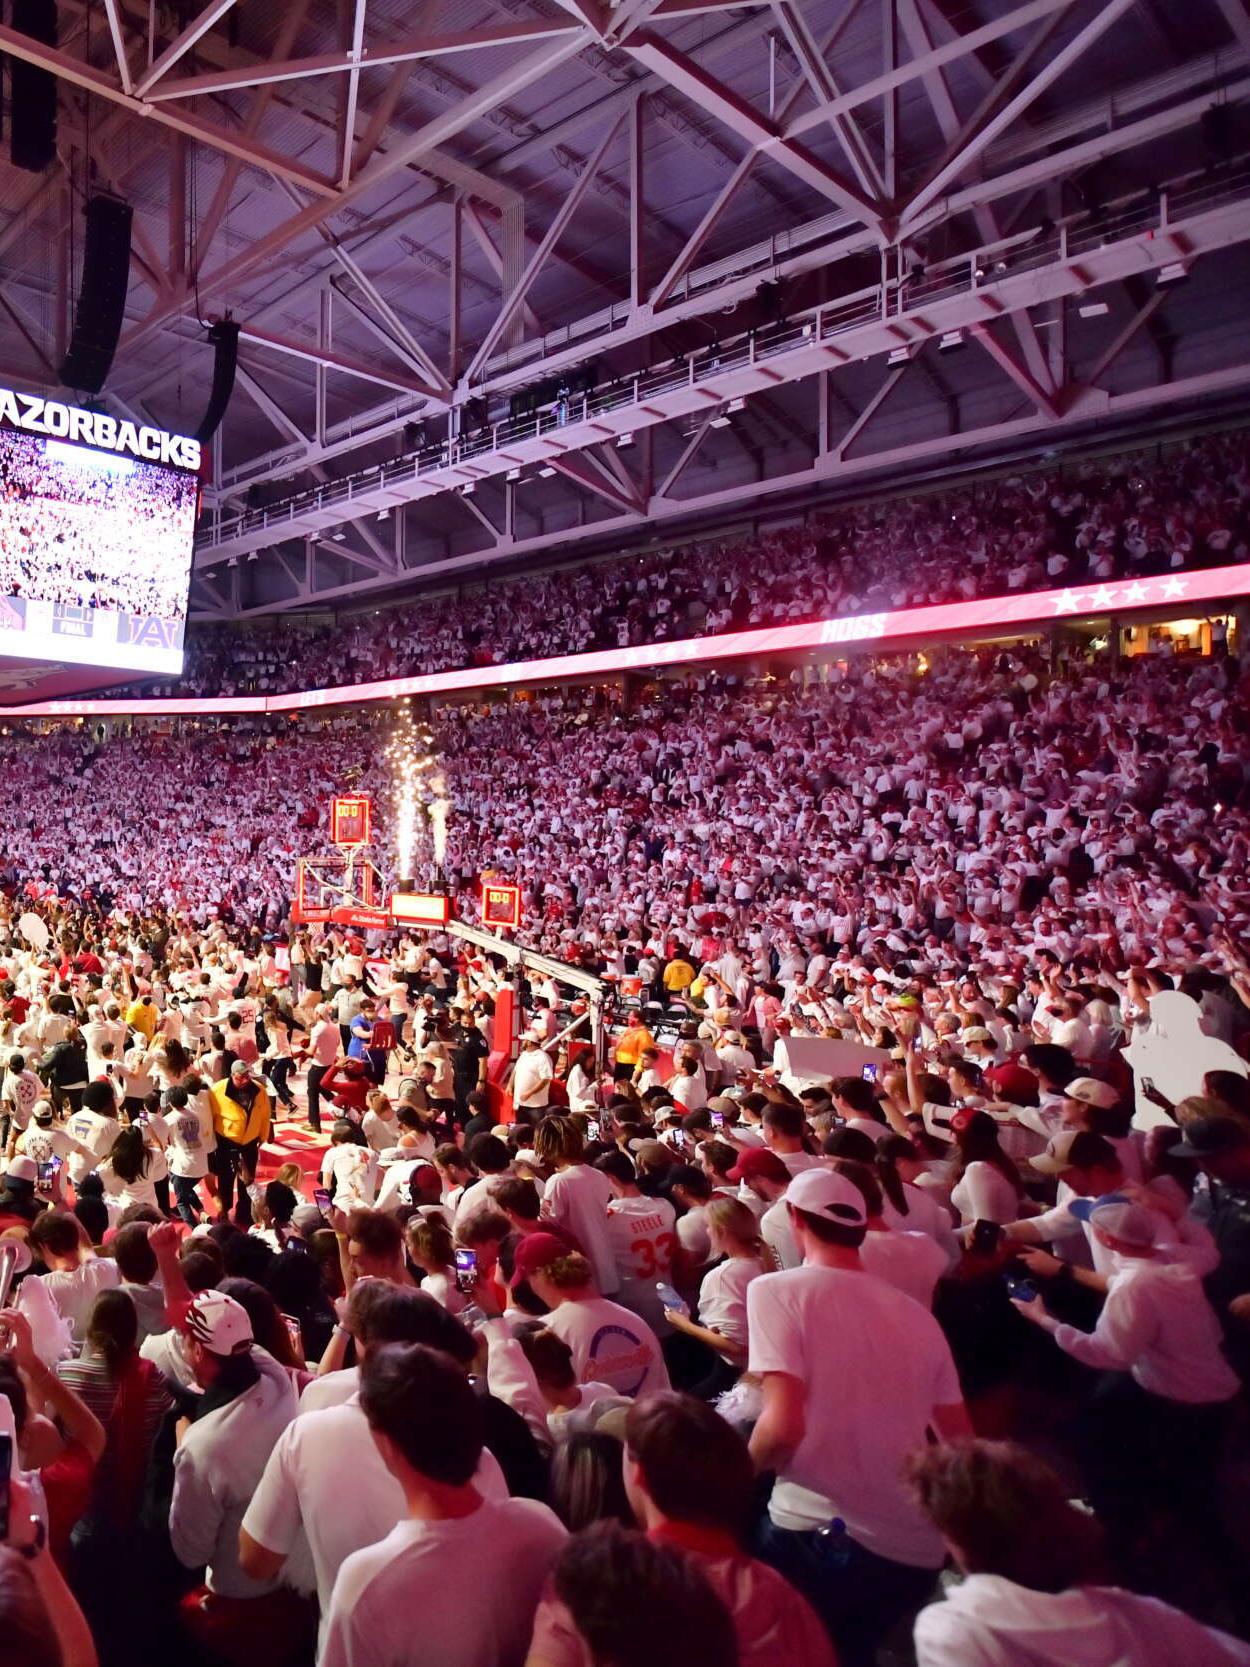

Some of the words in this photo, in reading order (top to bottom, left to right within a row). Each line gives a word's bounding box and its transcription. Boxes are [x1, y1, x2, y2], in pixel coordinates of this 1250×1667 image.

[60, 620, 87, 636] FINAL
[819, 612, 888, 644] HOGS
[242, 1009, 254, 1024] 25
[630, 1214, 664, 1234] STEELE
[631, 1232, 677, 1279] 33
